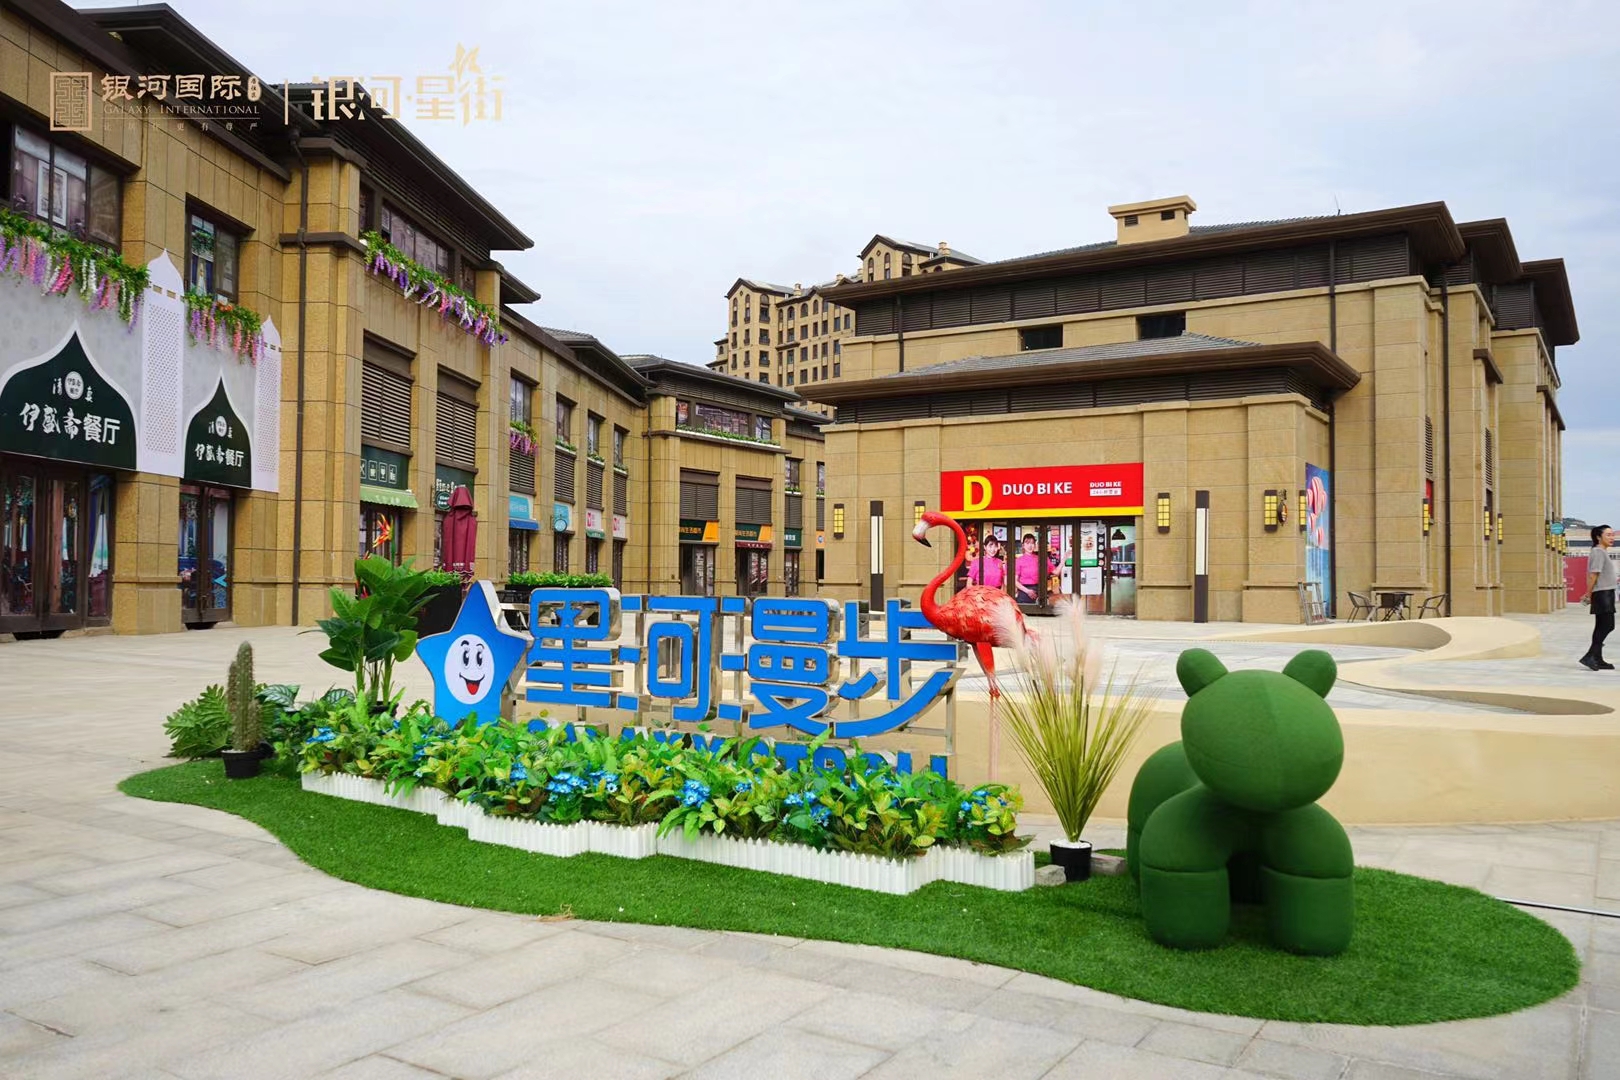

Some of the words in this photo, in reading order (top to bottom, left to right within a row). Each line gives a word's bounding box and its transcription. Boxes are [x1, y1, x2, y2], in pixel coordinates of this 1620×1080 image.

[963, 475, 993, 512] D
[1002, 483, 1034, 496] DUO
[525, 587, 958, 738] 星河漫步
